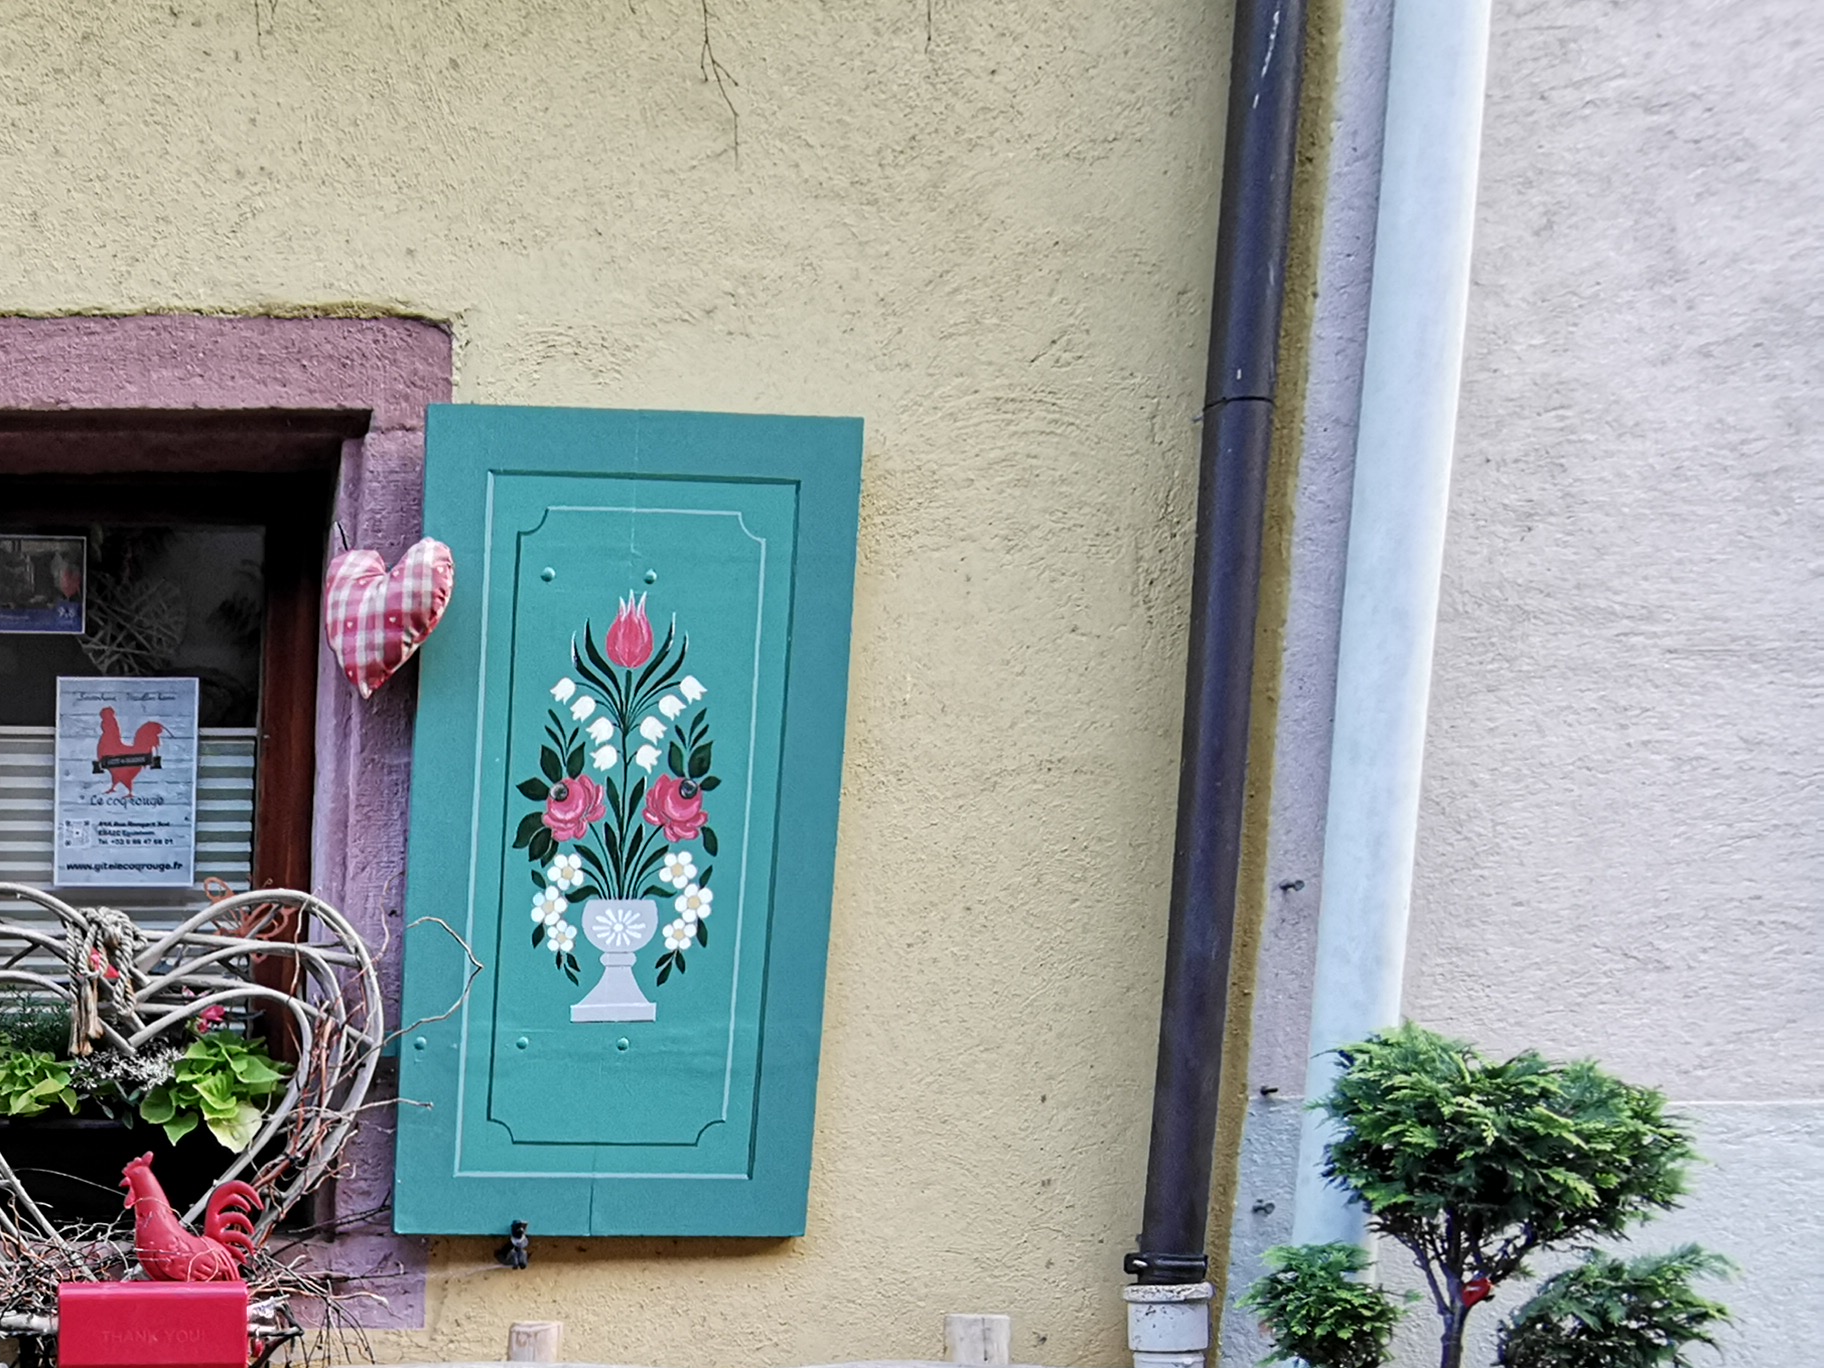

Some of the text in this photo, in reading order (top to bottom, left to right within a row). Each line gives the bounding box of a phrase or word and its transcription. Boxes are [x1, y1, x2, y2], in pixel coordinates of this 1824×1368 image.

[89, 794, 104, 806] Le
[66, 862, 183, 873] www.gitelecoqrouge.fr
[101, 1329, 158, 1344] THANK
